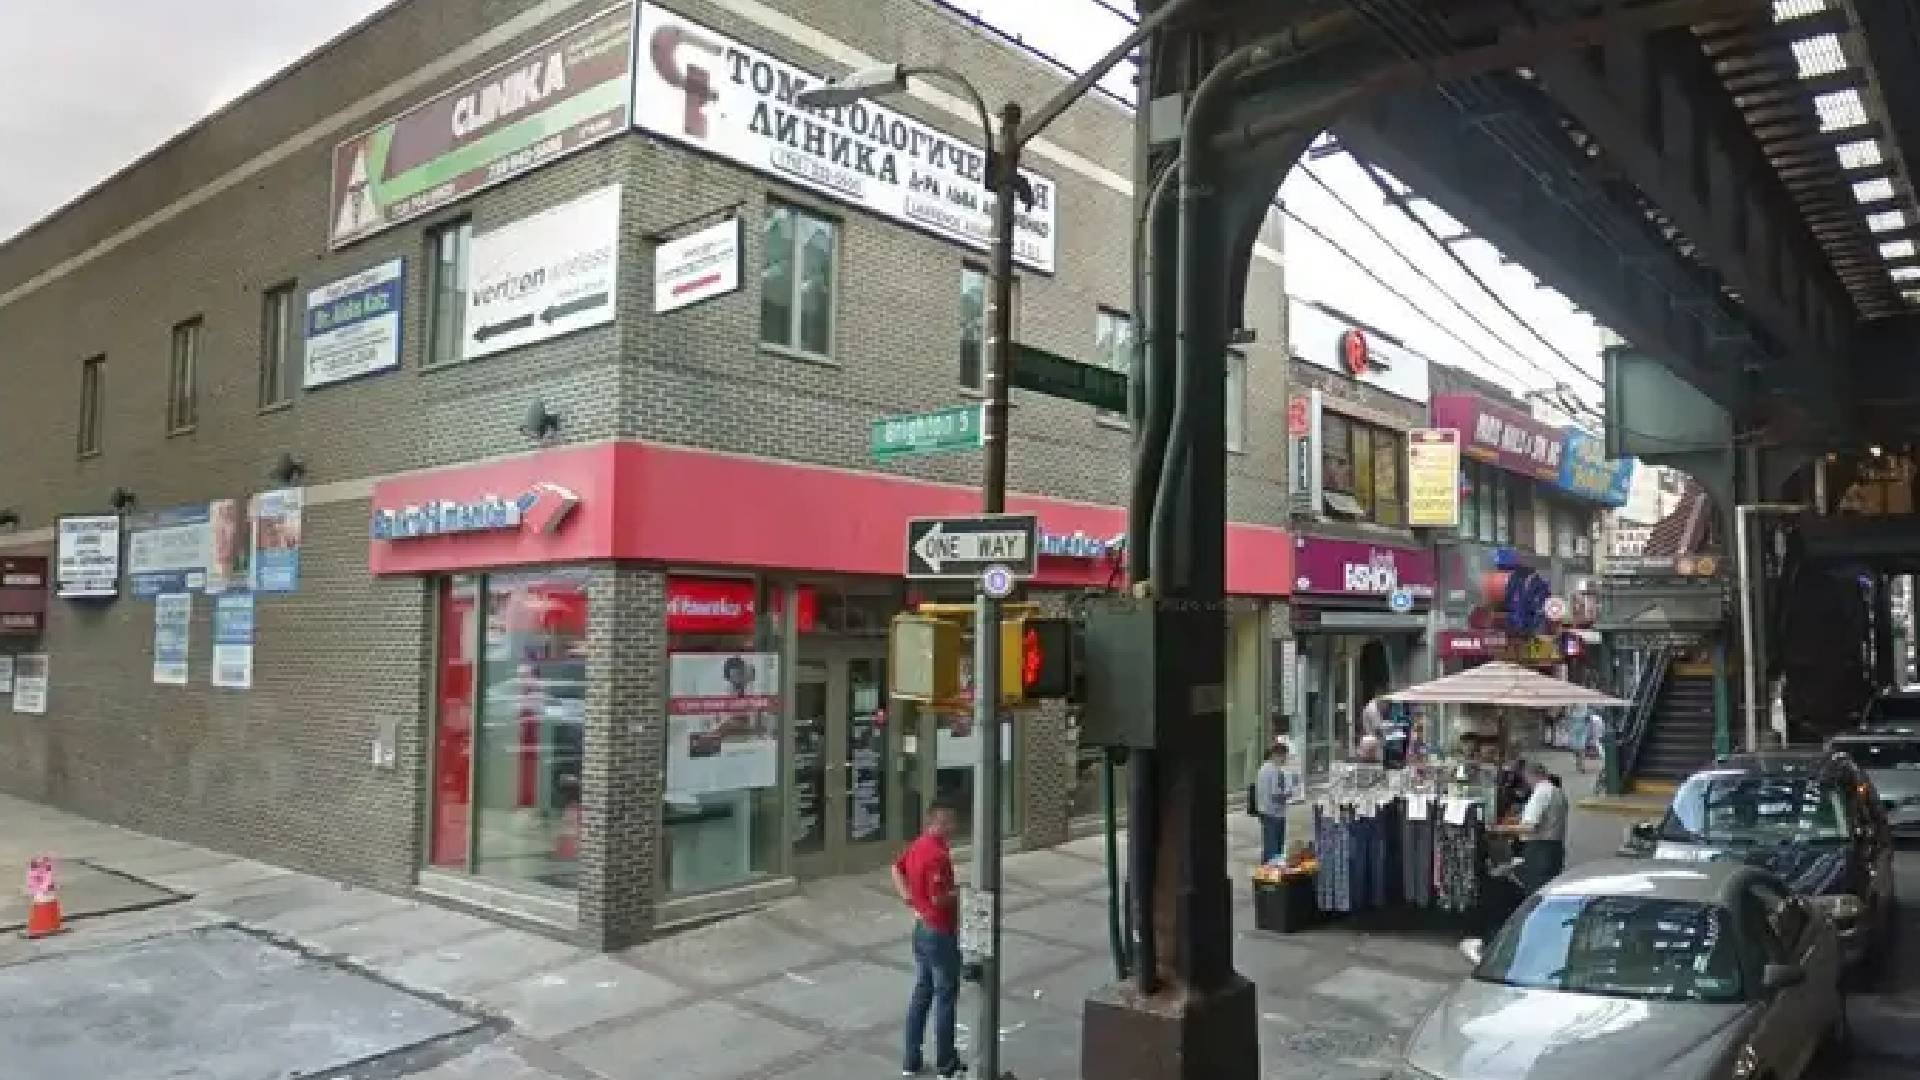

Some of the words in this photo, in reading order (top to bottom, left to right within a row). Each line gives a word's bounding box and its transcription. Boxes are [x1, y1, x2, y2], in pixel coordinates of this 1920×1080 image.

[747, 101, 899, 186] ЛИНИКА
[473, 266, 546, 307] verizon
[925, 535, 960, 558] ONE
[977, 535, 1019, 558] WAY
